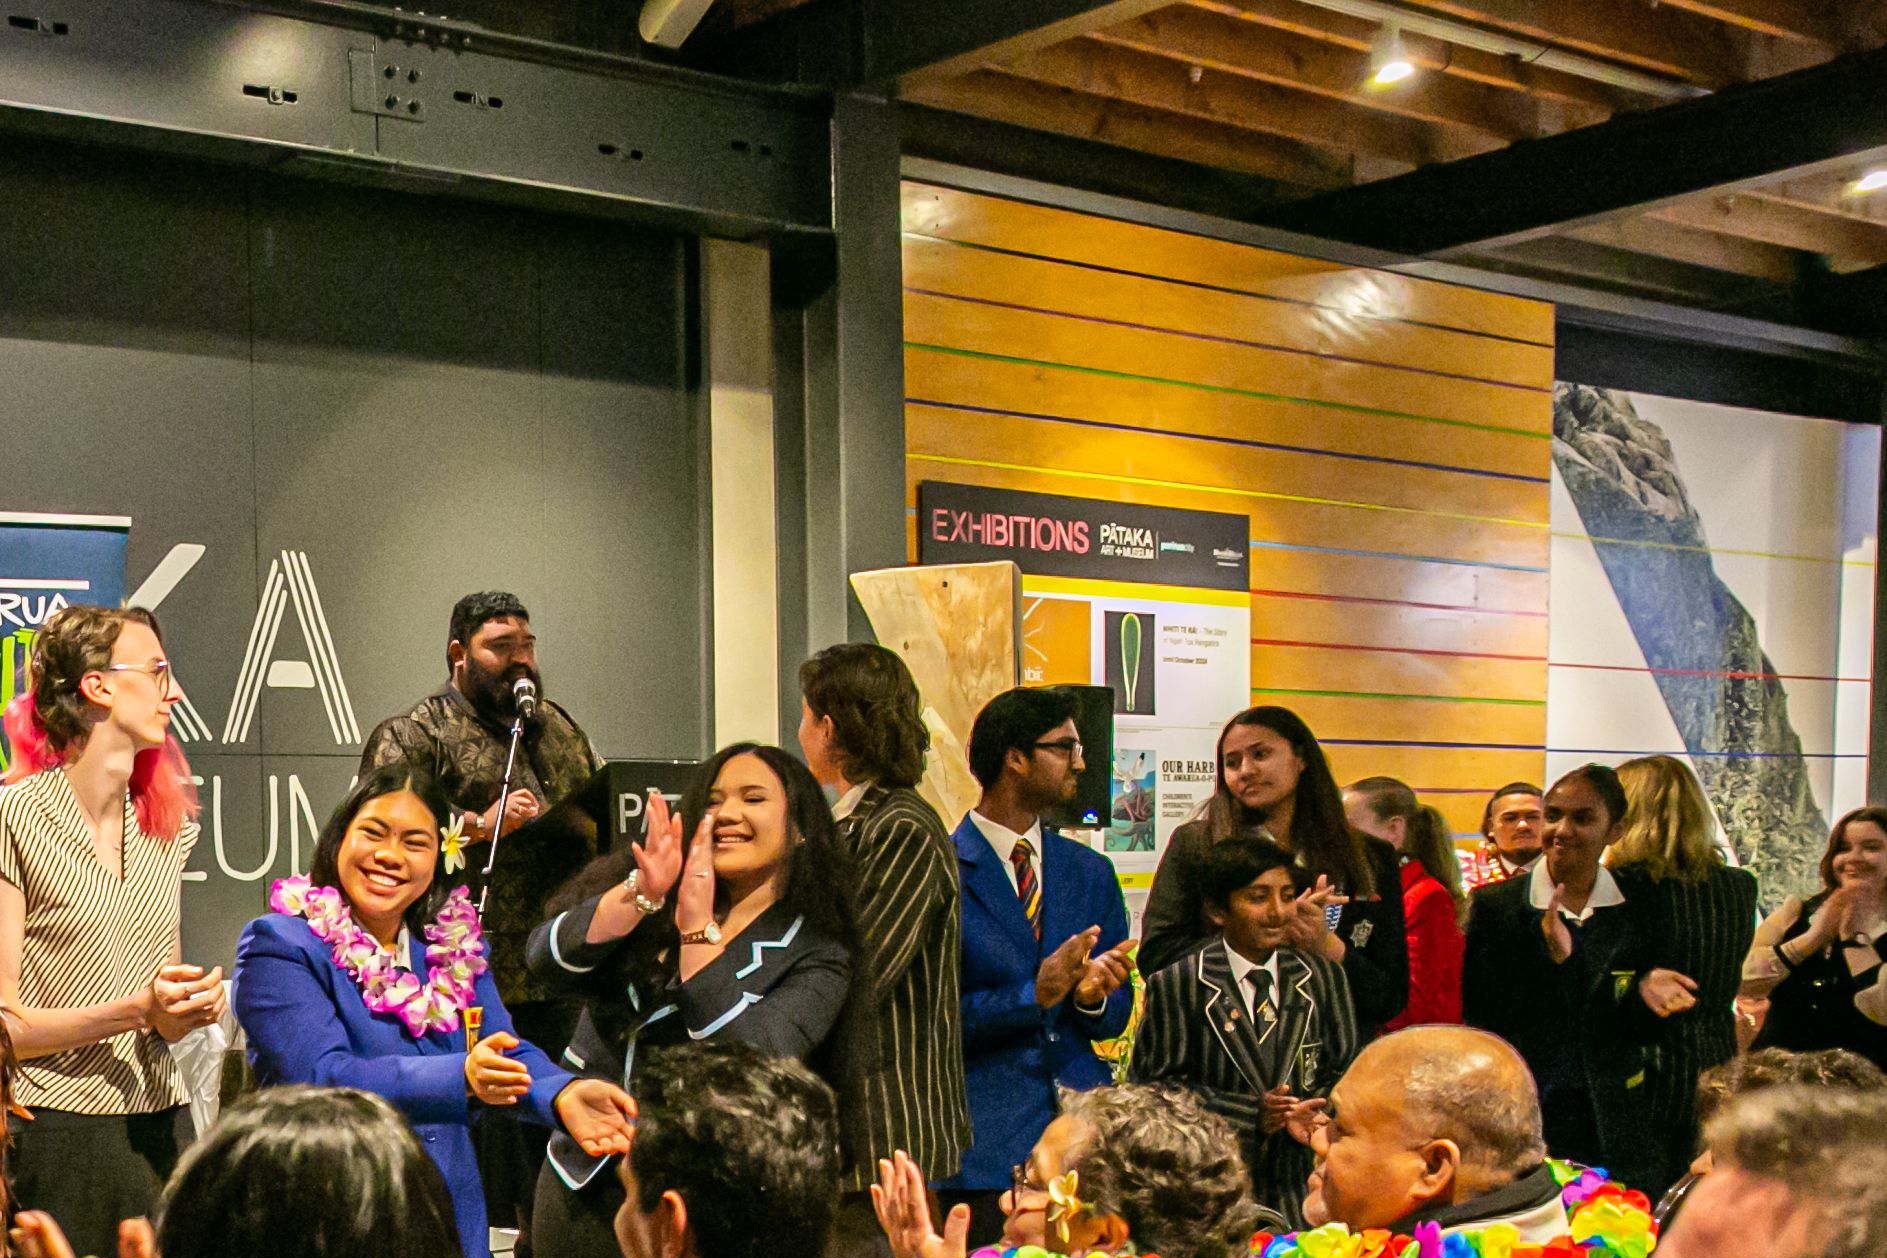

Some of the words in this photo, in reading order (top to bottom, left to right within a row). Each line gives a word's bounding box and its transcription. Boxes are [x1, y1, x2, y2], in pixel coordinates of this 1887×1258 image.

[931, 507, 1091, 555] EXHIBITIONS
[1099, 522, 1154, 548] PĀTAKA
[1162, 760, 1183, 773] OUR
[1186, 761, 1215, 774] HARB
